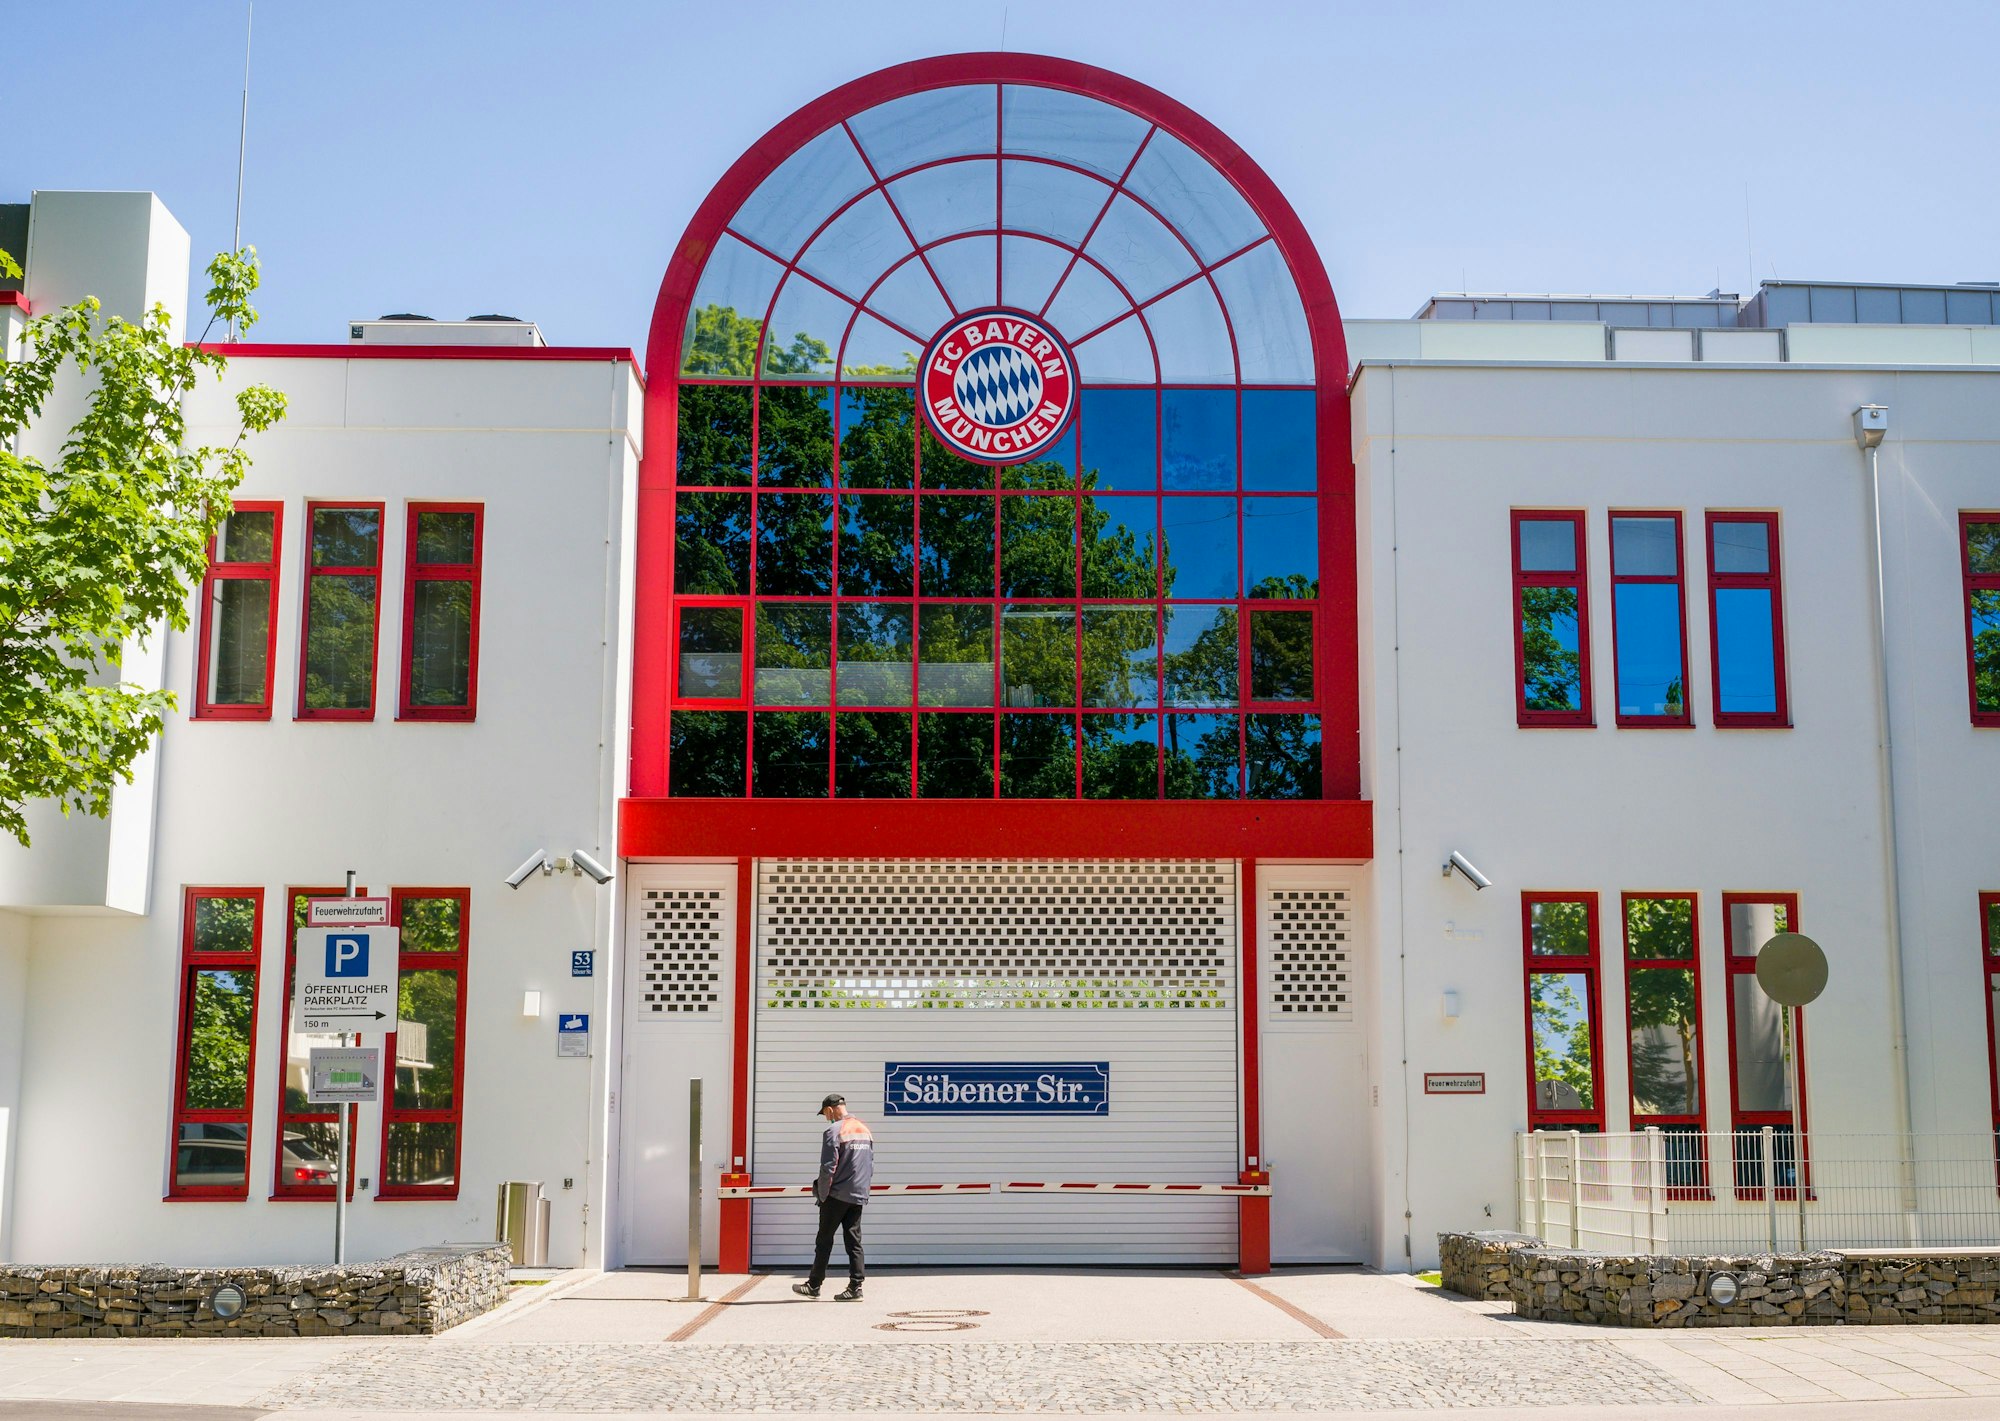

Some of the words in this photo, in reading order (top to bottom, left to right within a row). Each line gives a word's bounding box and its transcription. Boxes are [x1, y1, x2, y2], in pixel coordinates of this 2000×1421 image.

[934, 341, 963, 376] FC
[963, 321, 1064, 380] BAYERN
[934, 396, 1063, 451] MÜNCHEN
[316, 906, 382, 916] Feuerwehrzufahrt
[335, 939, 360, 973] P
[574, 952, 591, 965] 53
[304, 983, 388, 994] ÖFFENTLICHER
[304, 996, 368, 1005] PARKPLATZ
[303, 1020, 319, 1028] 150
[903, 1074, 1029, 1104] Säbener
[1036, 1074, 1090, 1104] Str.
